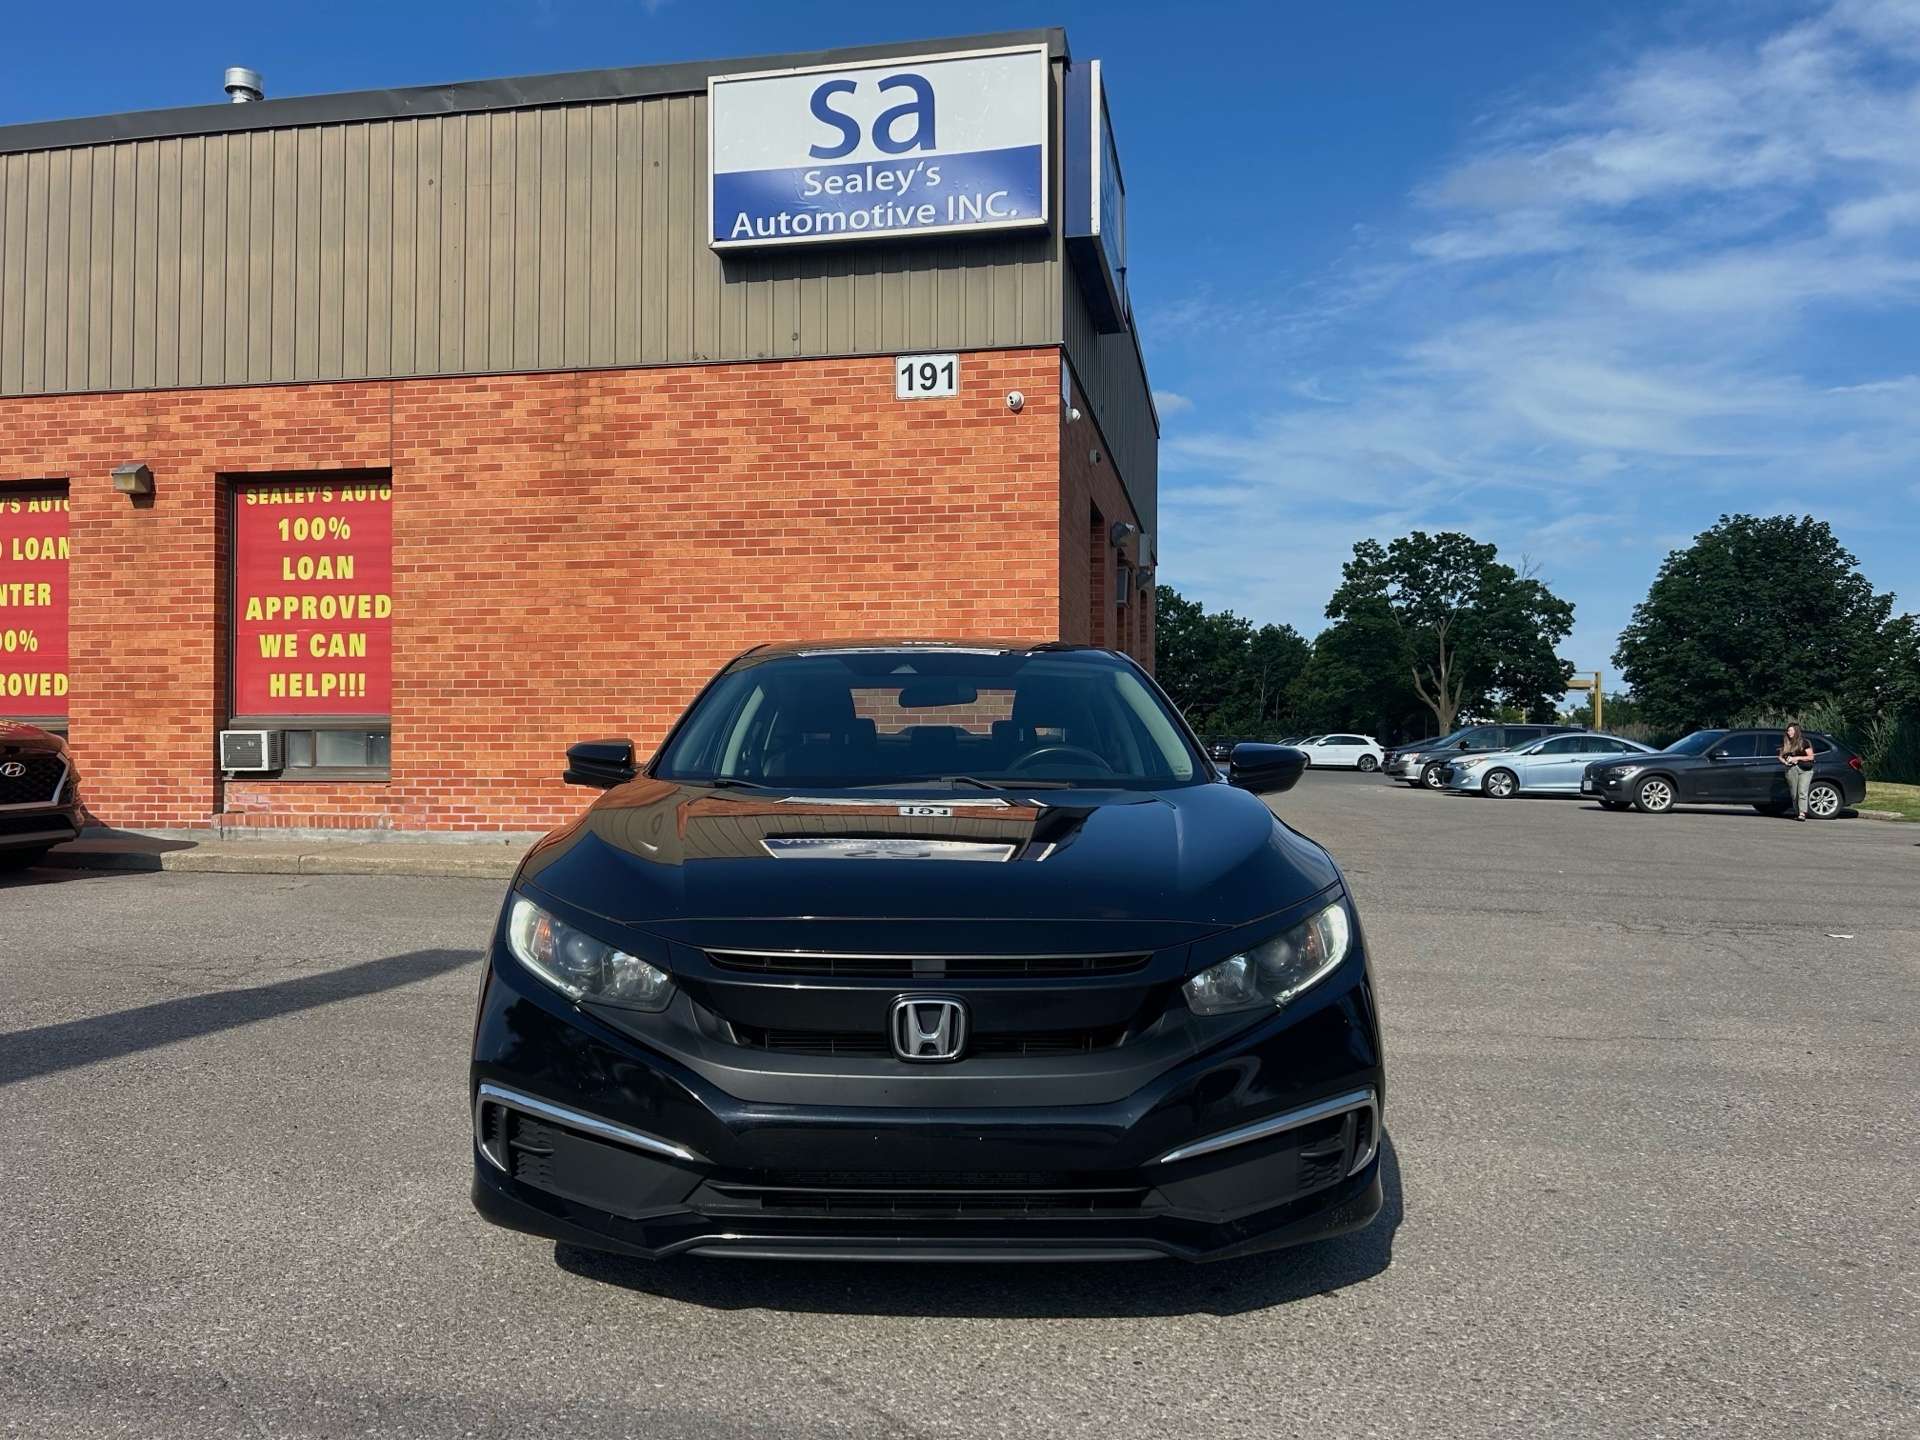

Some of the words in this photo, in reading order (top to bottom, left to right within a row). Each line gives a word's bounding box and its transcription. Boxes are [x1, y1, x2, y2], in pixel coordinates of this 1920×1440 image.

[808, 73, 936, 159] sa
[731, 201, 936, 238] Automotive
[947, 190, 1019, 221] INC.
[901, 361, 955, 391] 191
[246, 486, 333, 505] SEALEY'S
[341, 484, 391, 501] AUTO
[278, 516, 350, 541] 100%
[282, 555, 354, 580] LOAN
[245, 594, 392, 620] APPROVED
[259, 633, 298, 658] WE
[309, 633, 366, 657] CAN
[270, 672, 366, 697] HELP!!!
